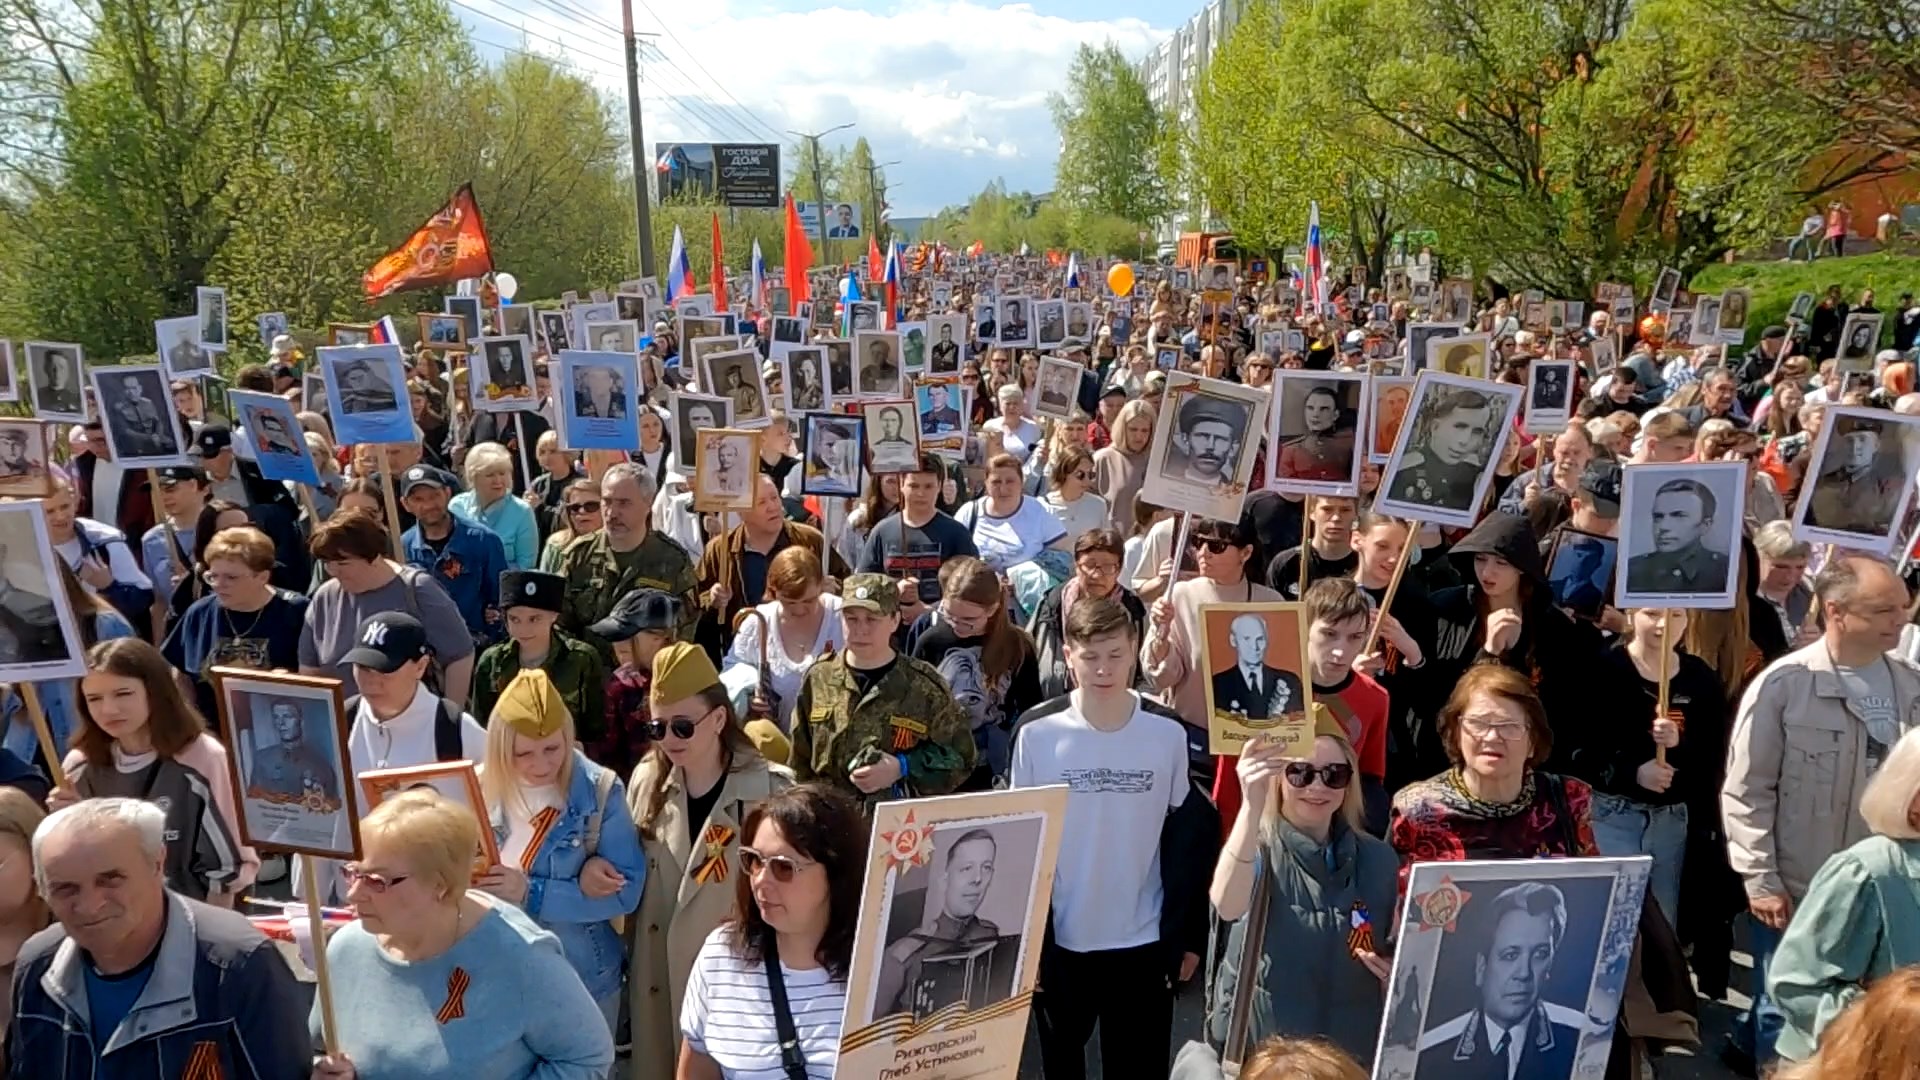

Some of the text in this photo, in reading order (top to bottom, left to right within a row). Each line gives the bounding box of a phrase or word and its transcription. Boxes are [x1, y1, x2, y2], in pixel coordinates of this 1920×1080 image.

[722, 148, 769, 157] ГОСТЕВОЙ
[730, 156, 760, 166] ДОМ
[362, 620, 389, 646] NY
[879, 1045, 985, 1080] Глеб Устинович
